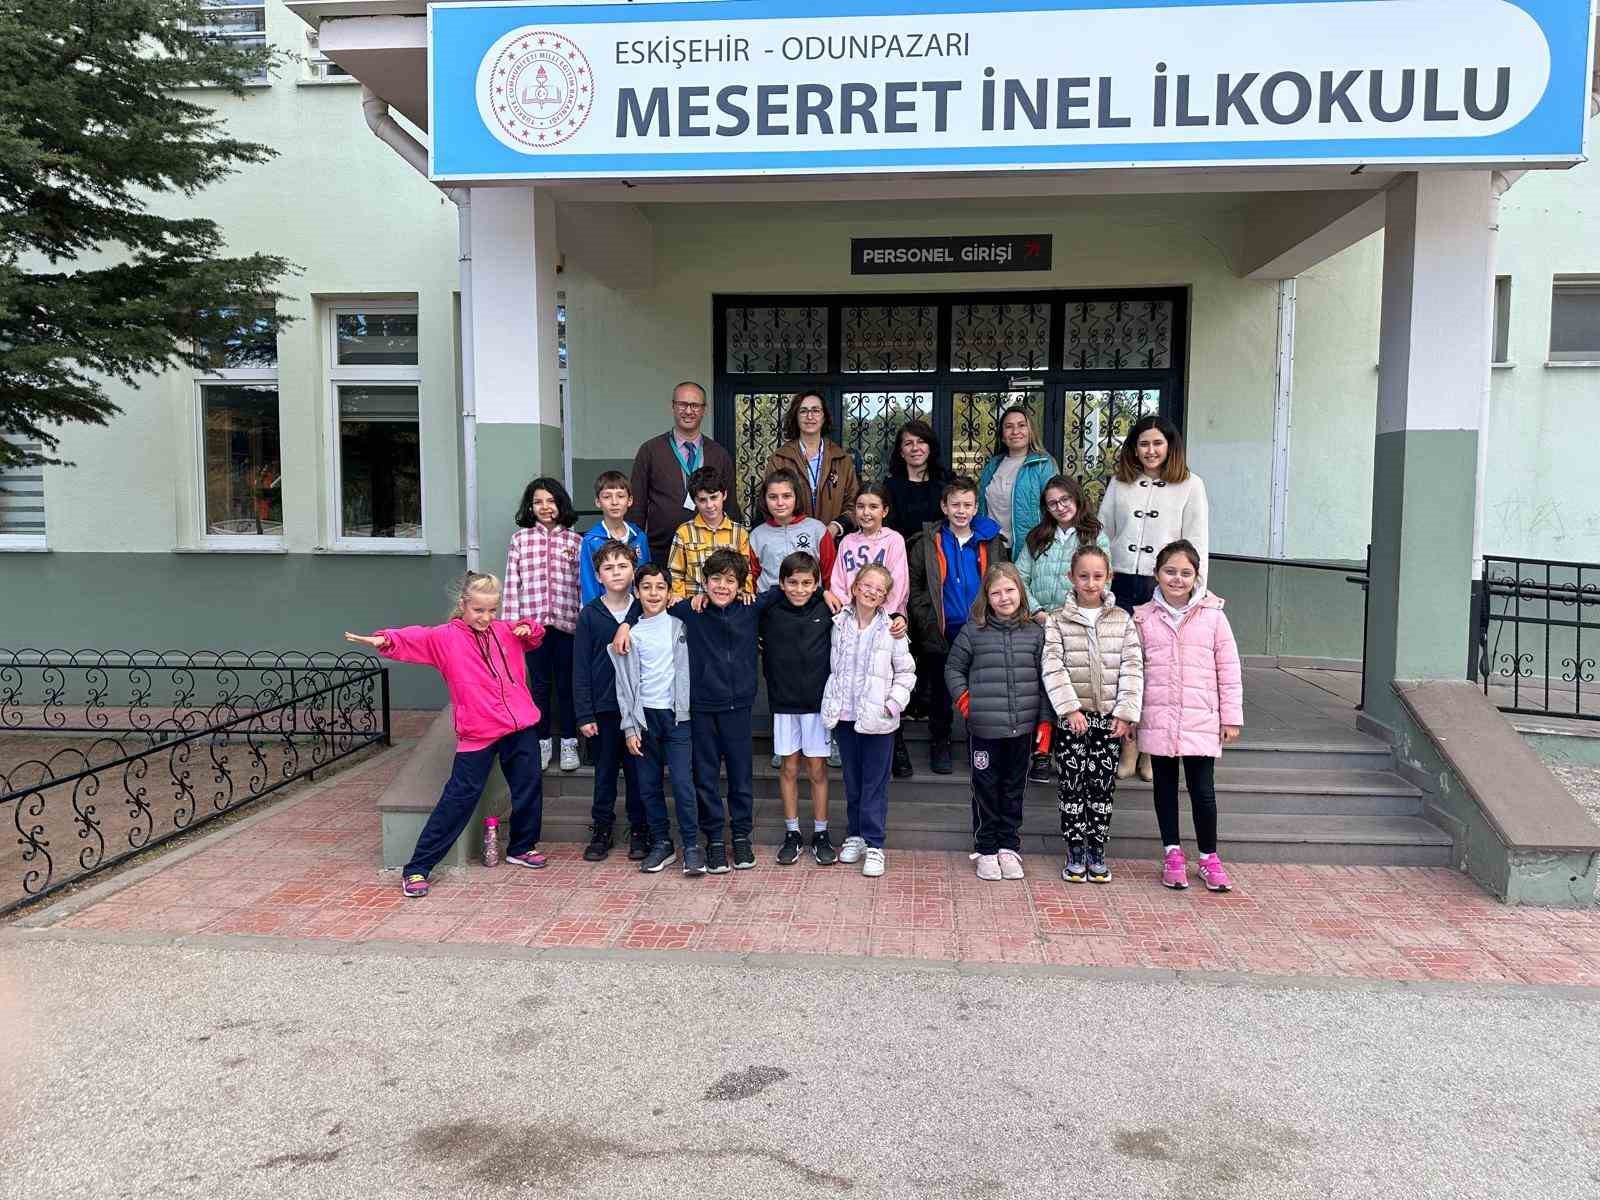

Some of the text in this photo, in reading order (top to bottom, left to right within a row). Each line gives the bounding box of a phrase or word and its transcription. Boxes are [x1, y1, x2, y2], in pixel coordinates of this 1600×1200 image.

[616, 35, 749, 69] ESKİŞEHİR
[783, 33, 968, 60] ODUNPAZARI
[616, 62, 1511, 137] MESERRET İNEL İLKOKULU
[863, 242, 1012, 264] PERSONEL GİRİŞİ
